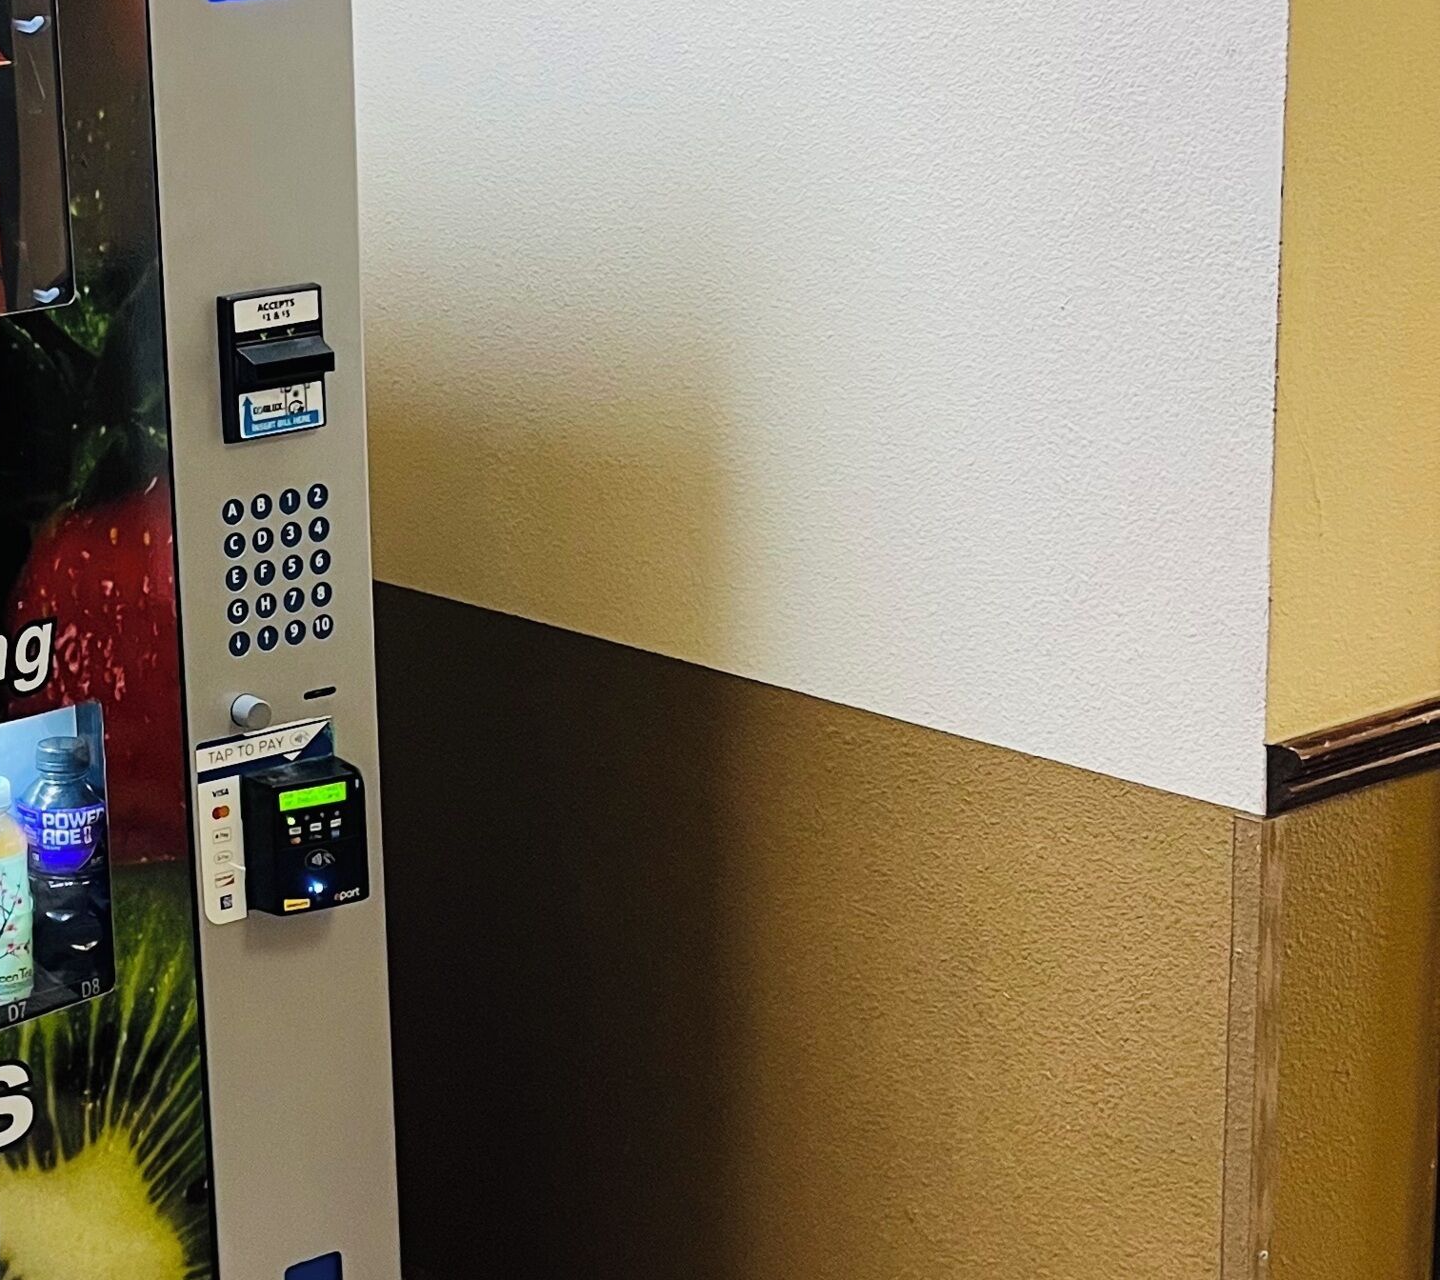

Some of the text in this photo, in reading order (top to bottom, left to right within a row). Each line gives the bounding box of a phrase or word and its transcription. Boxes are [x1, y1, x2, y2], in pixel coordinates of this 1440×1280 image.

[257, 298, 295, 312] ACCEPTS
[227, 487, 322, 518] A B 1 2
[229, 520, 322, 550] C D 3 4
[231, 553, 323, 584] E F 5 6
[232, 586, 325, 616] G H 7 8
[290, 617, 330, 637] 9 10
[208, 736, 285, 764] TAP TO PAY
[212, 788, 229, 797] VISA
[81, 977, 101, 1000] D8
[7, 1001, 28, 1023] D7
